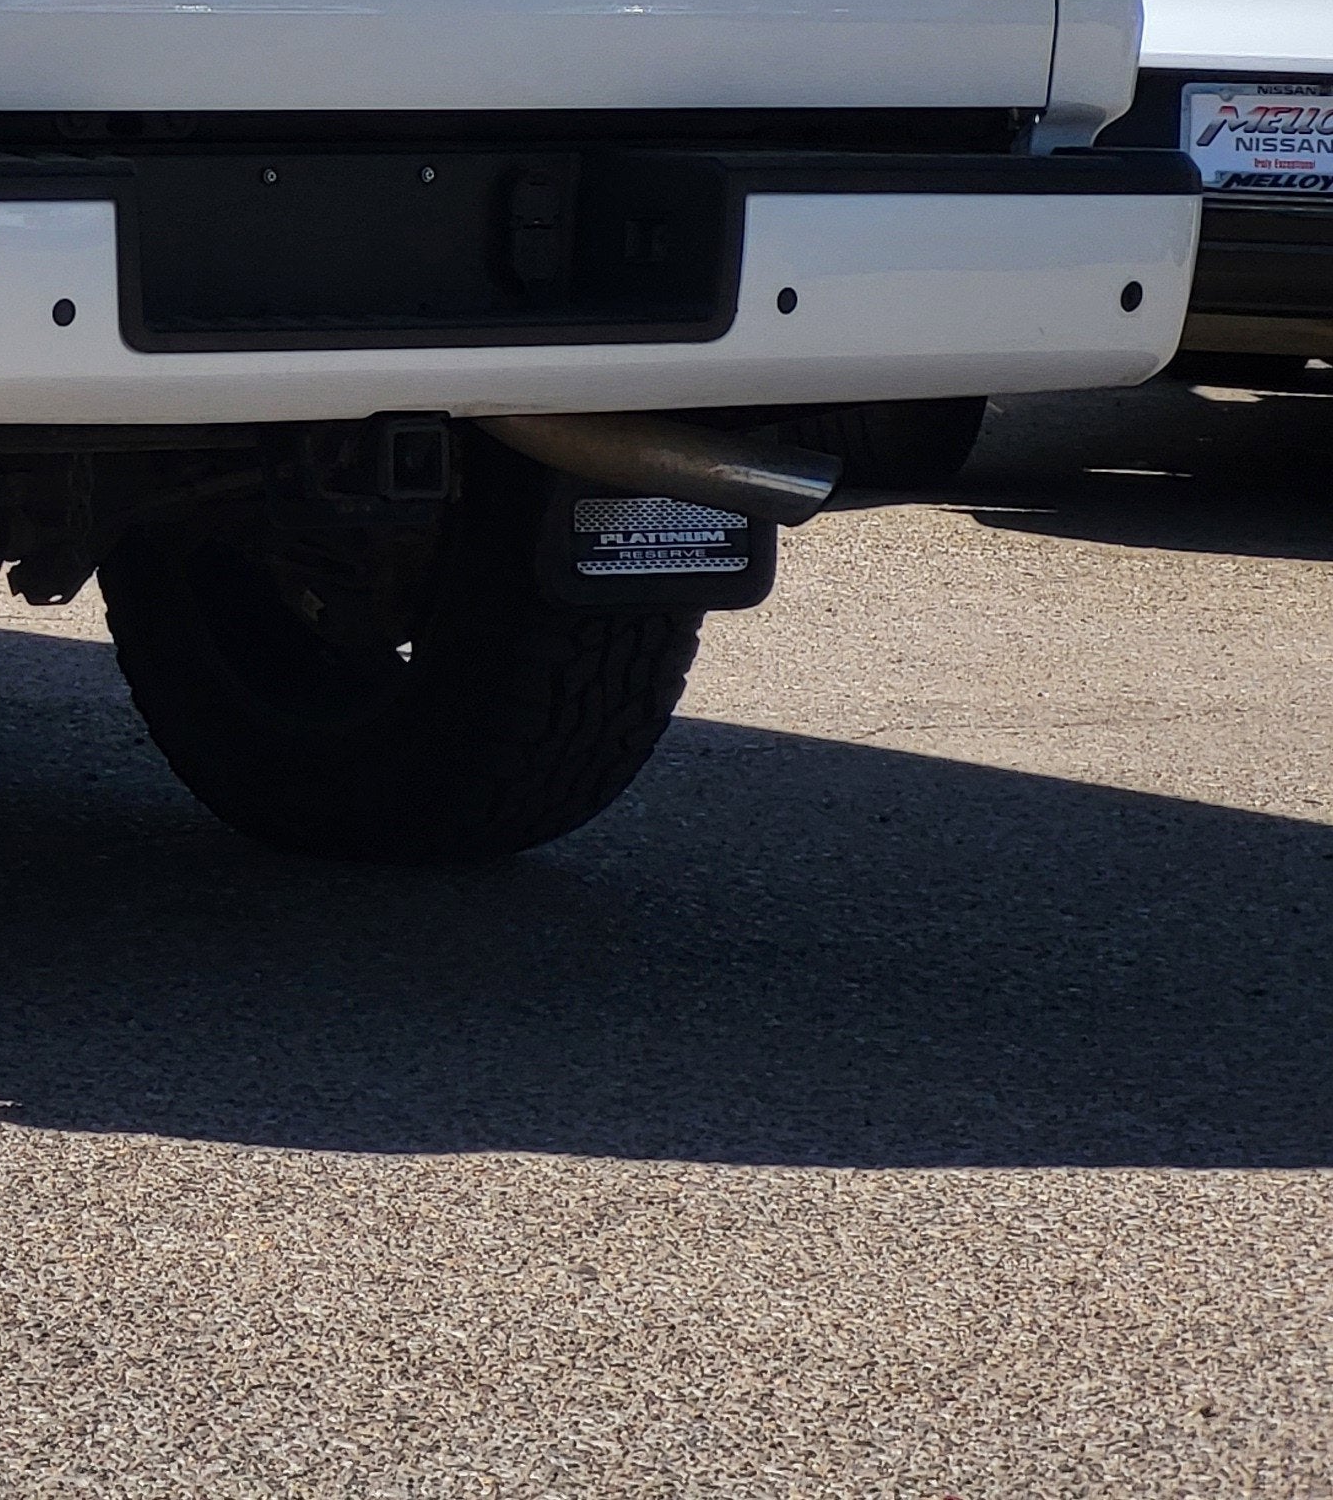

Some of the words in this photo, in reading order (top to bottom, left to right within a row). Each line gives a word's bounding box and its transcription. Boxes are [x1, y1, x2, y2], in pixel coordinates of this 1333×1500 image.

[1257, 85, 1317, 96] NISSAN
[1235, 137, 1333, 154] NISSAN
[1221, 173, 1333, 191] MELLOY
[600, 530, 726, 545] PLATINUM
[619, 549, 707, 560] RESERVE
